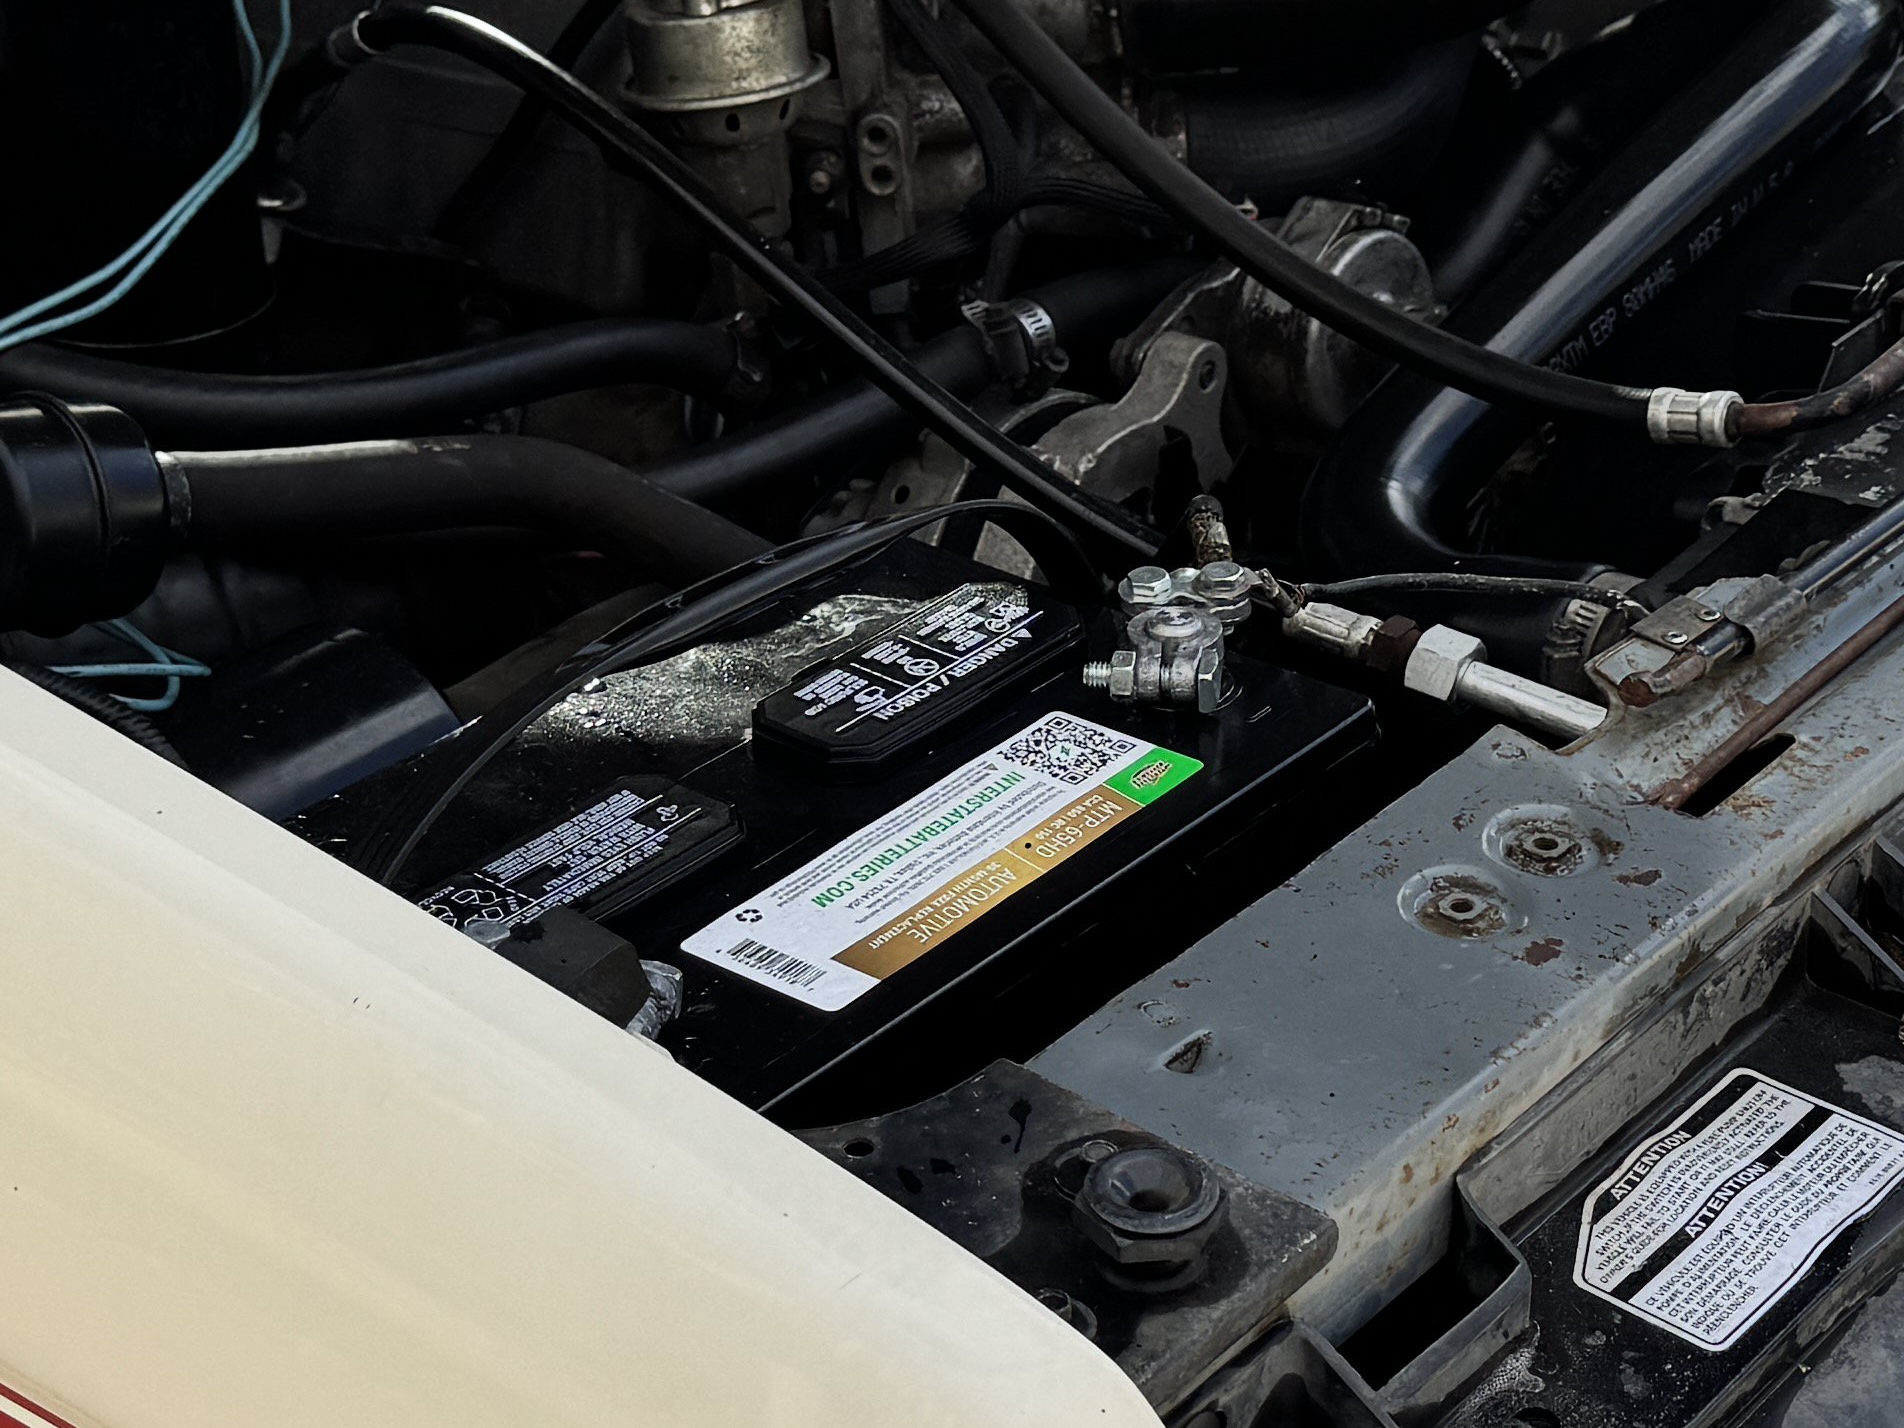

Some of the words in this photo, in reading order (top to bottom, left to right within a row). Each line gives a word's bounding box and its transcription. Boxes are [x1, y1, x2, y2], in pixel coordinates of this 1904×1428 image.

[945, 635, 1022, 679] DANGER
[870, 681, 943, 722] POISON
[807, 770, 1028, 908] INTERSTATEBATTERIES.COM
[1029, 799, 1127, 859] MTP-65HD
[863, 904, 935, 950] REPLACEMENT
[901, 866, 1024, 943] AUTOMOTIVE
[1607, 1128, 1692, 1201] ATTENTION
[1666, 1180, 1692, 1205] START
[1680, 1160, 1770, 1239] ATTENTION!
[1740, 1221, 1785, 1267] CONSULTER
[1743, 1248, 1777, 1279] TROUVE
[1770, 1230, 1792, 1249] CET
